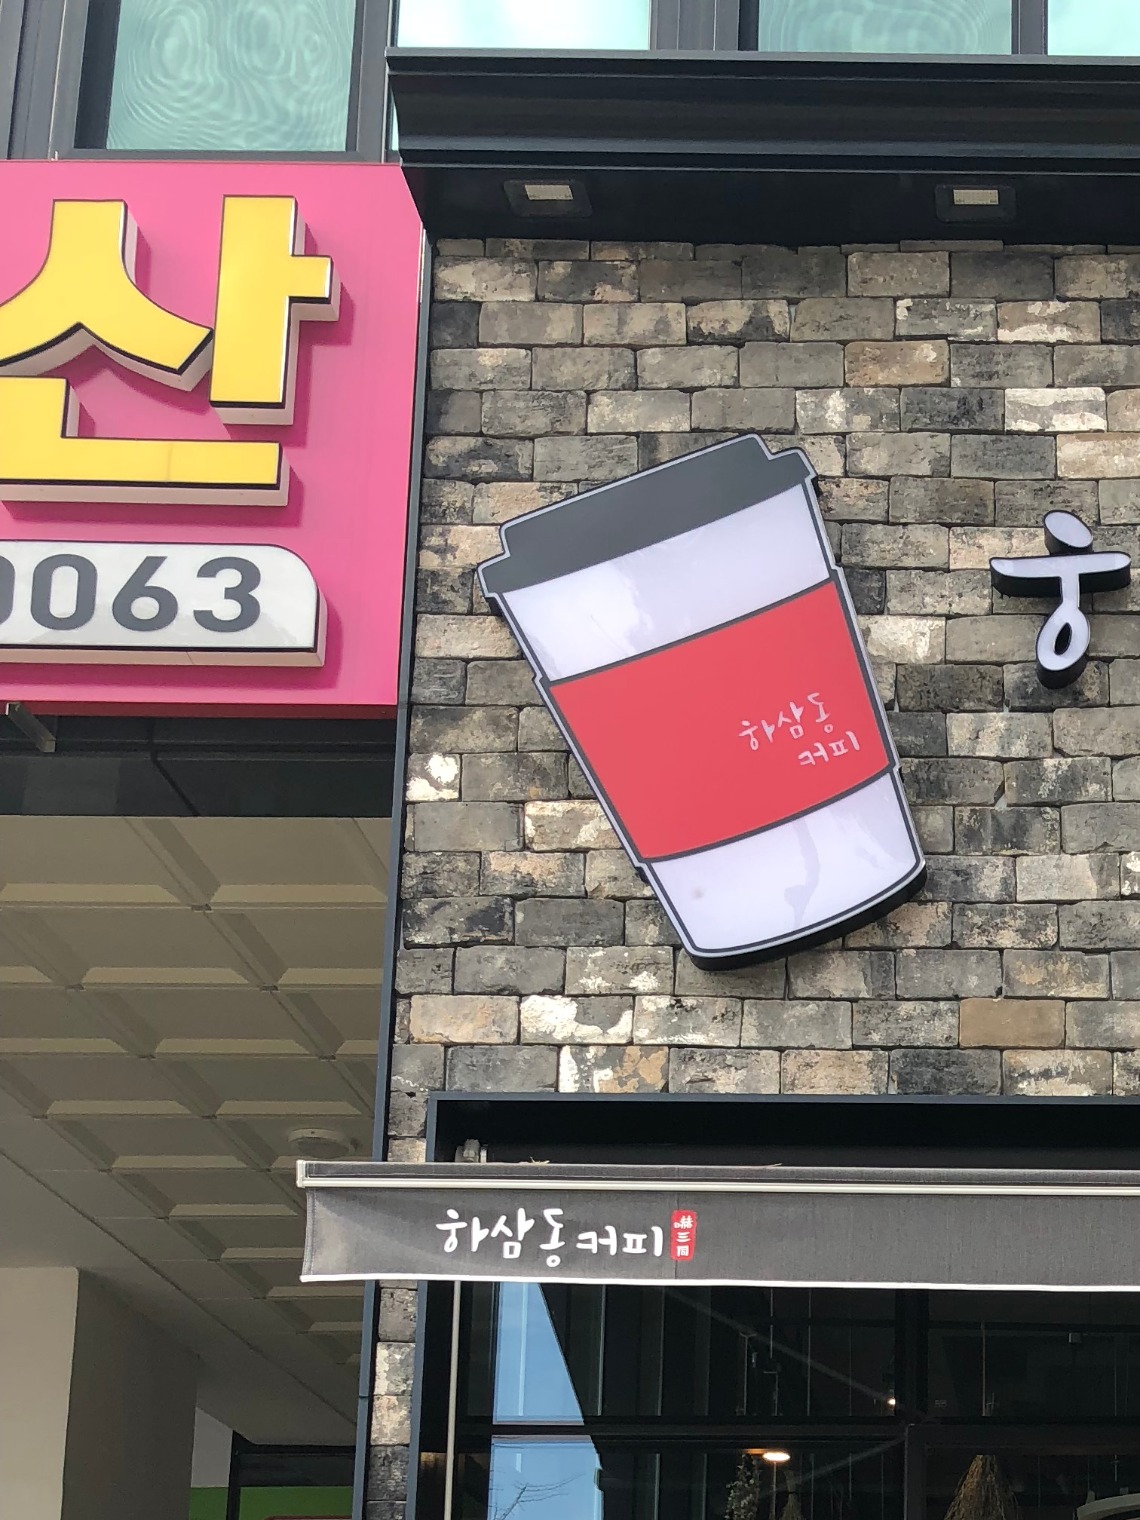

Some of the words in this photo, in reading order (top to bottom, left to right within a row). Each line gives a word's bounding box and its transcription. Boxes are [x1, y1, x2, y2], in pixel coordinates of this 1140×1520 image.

[0, 195, 332, 487] 산
[0, 554, 262, 633] 063
[739, 692, 831, 750] 하삼동
[798, 731, 860, 765] 커피
[436, 1207, 565, 1267] 하삼동
[576, 1225, 663, 1257] 커피
